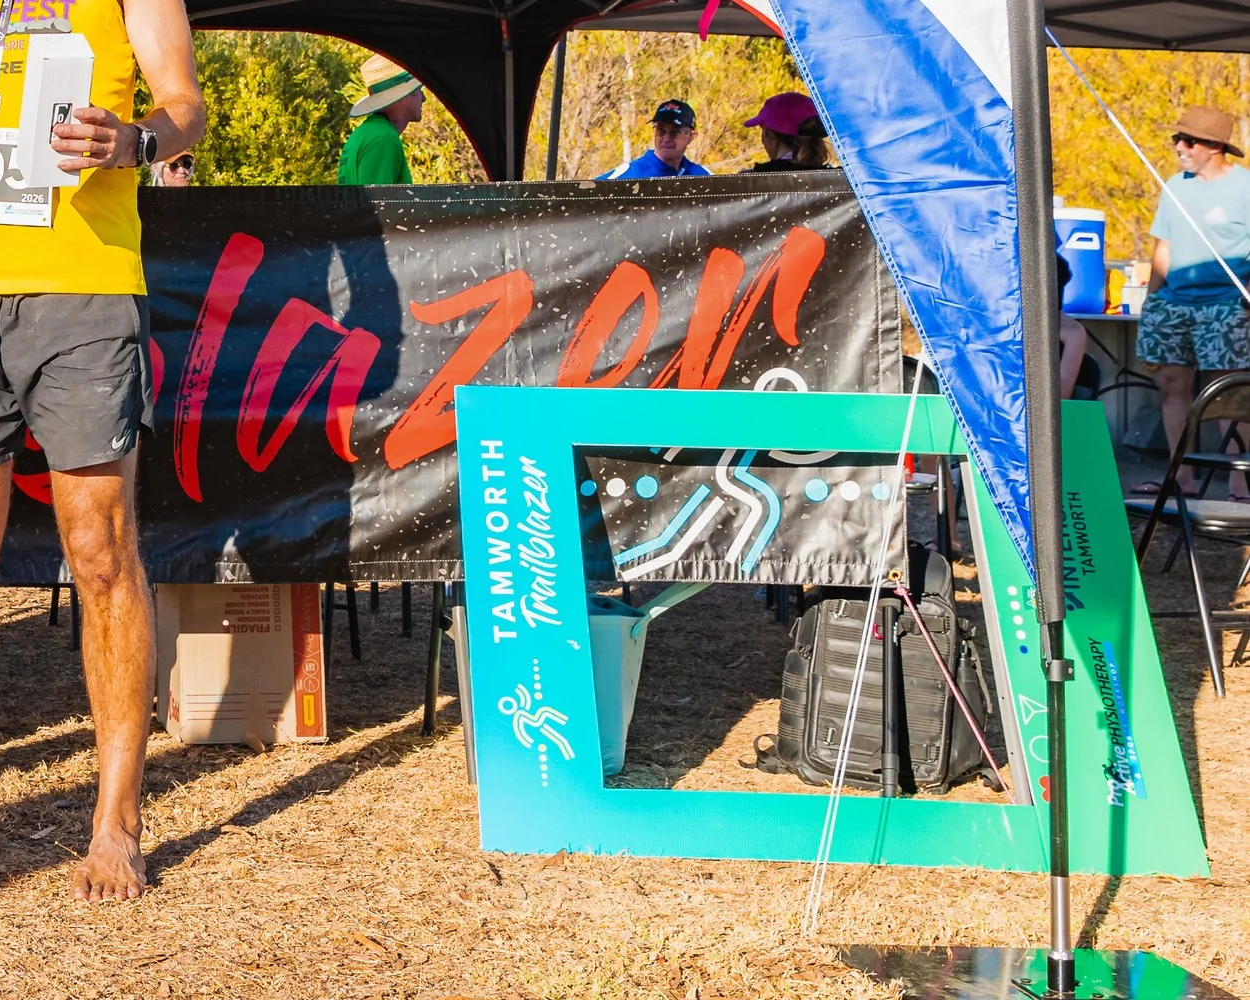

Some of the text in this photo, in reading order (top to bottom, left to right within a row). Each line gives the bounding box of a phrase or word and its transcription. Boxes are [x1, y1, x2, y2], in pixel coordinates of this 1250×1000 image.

[21, 193, 45, 203] 2026
[480, 439, 517, 643] TAMWORTH
[517, 455, 563, 628] Trailblazer
[1070, 491, 1096, 576] TAMWORTH
[223, 624, 270, 633] FRAGILE
